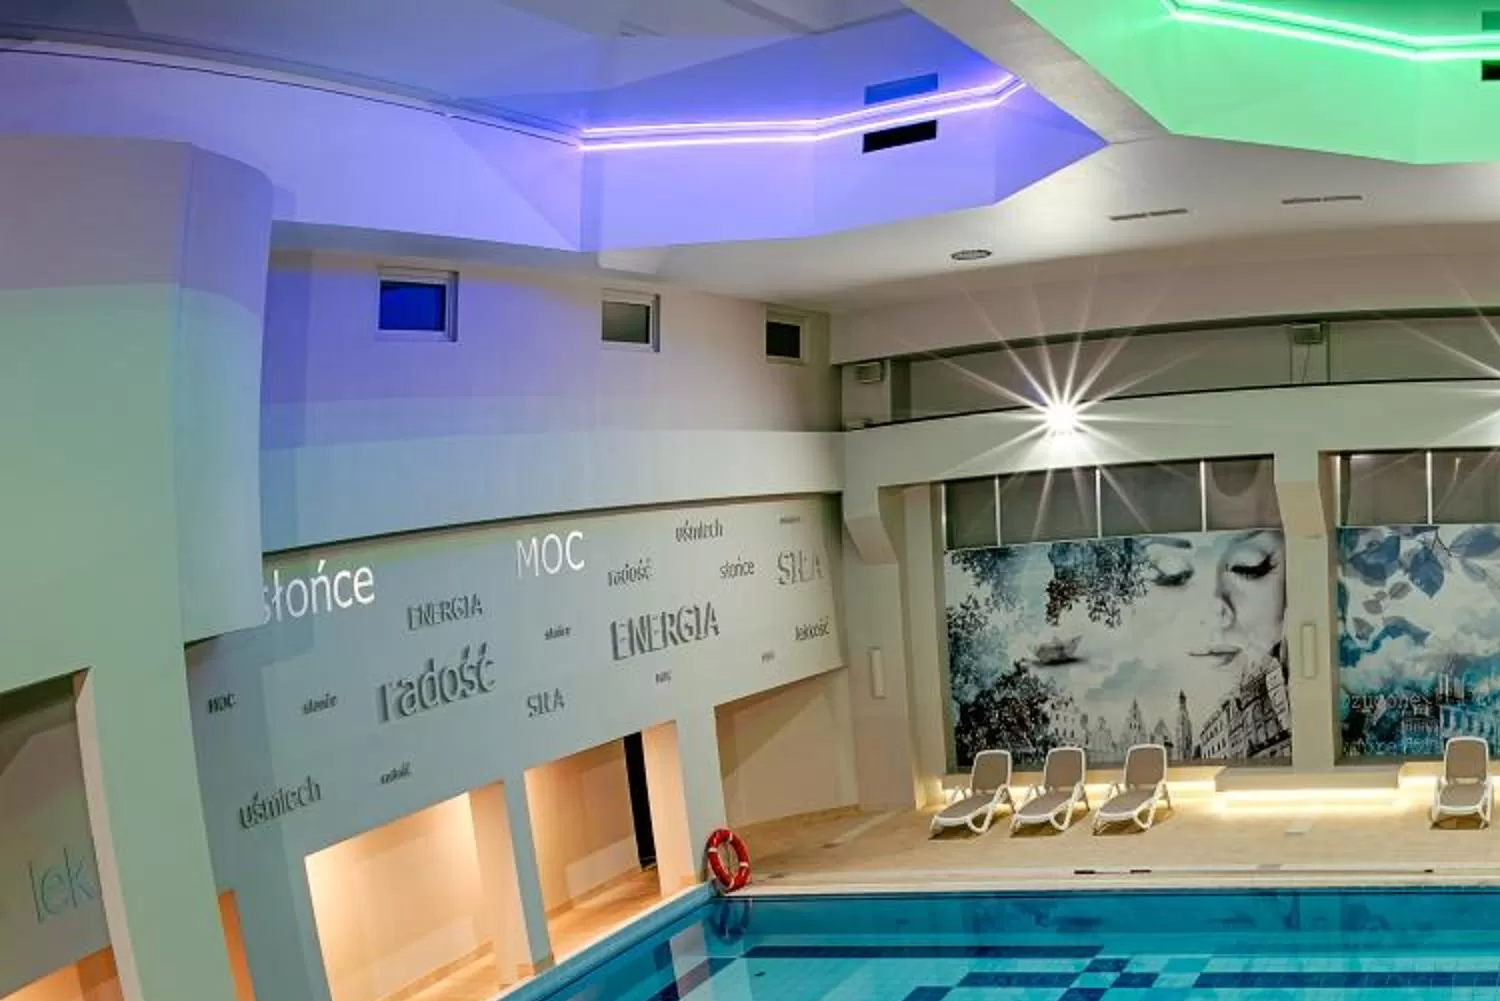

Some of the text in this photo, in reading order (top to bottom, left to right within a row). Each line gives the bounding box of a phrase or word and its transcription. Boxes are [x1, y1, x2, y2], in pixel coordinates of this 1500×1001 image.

[516, 531, 585, 577] MOC
[405, 593, 485, 631] ENERGIA
[609, 601, 720, 661] ENERGIA
[377, 641, 497, 722] radość
[526, 688, 566, 718] SIŁA
[239, 774, 322, 830] uśmiech
